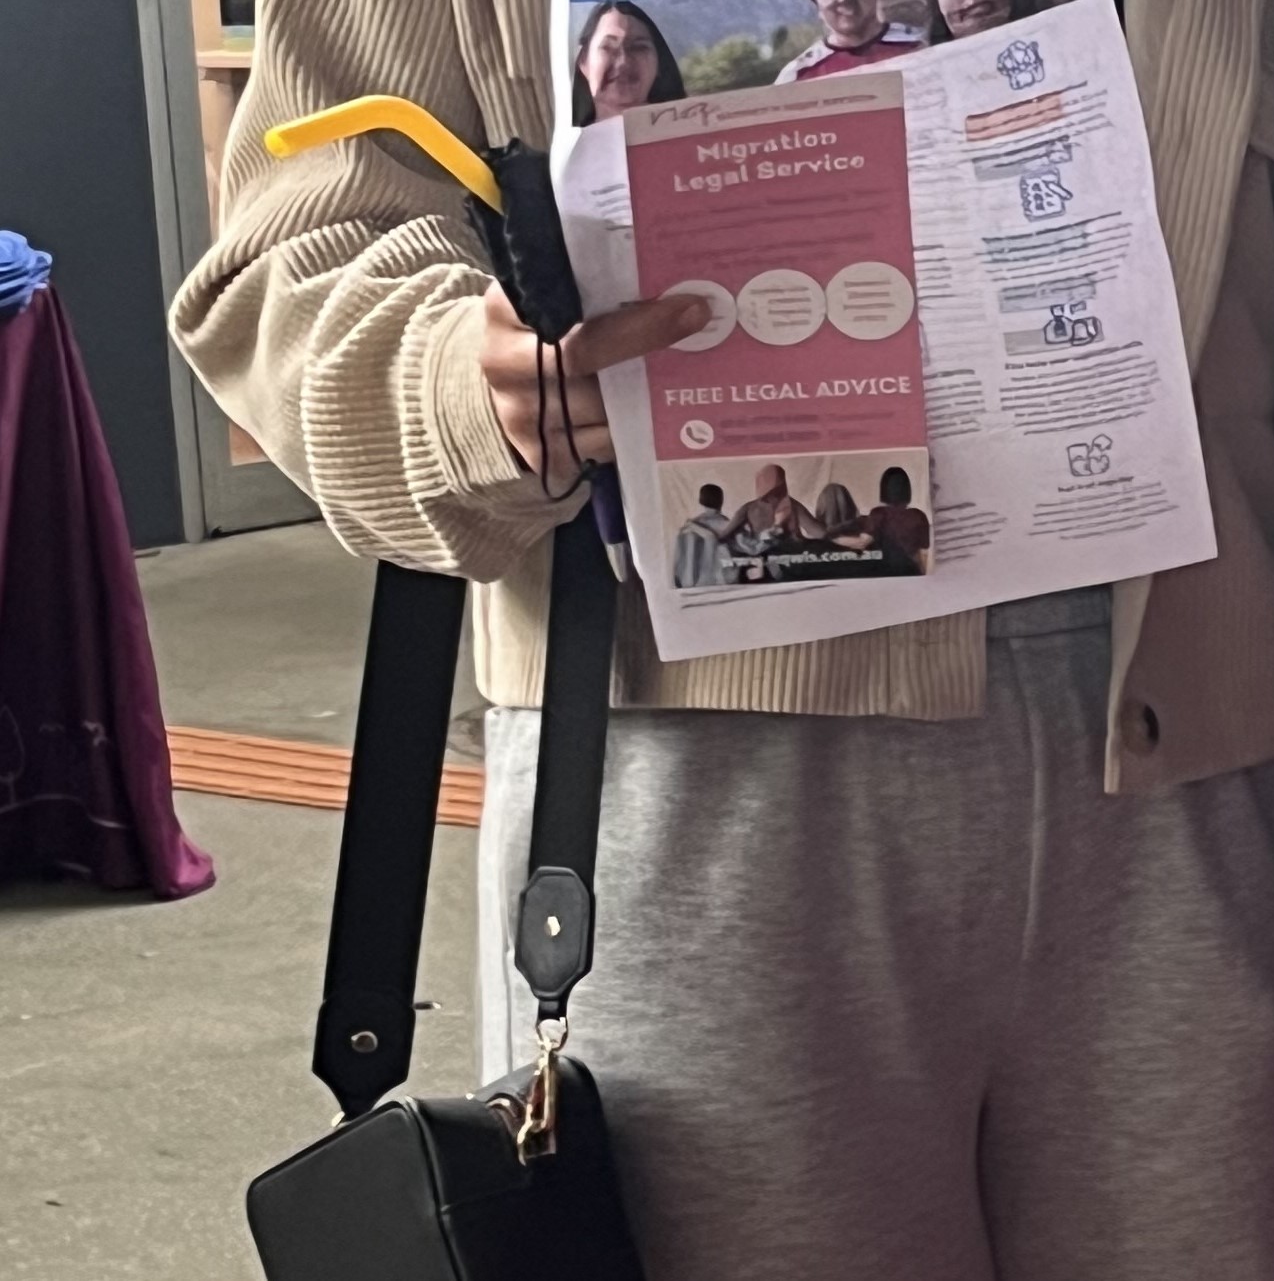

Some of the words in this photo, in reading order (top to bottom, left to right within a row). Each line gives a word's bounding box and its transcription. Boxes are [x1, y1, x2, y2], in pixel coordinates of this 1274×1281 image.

[697, 130, 837, 164] Migration
[673, 165, 749, 192] Legal
[757, 153, 865, 180] Service
[664, 386, 723, 407] FREE
[731, 381, 809, 402] LEGAL
[815, 375, 912, 399] ADVICE
